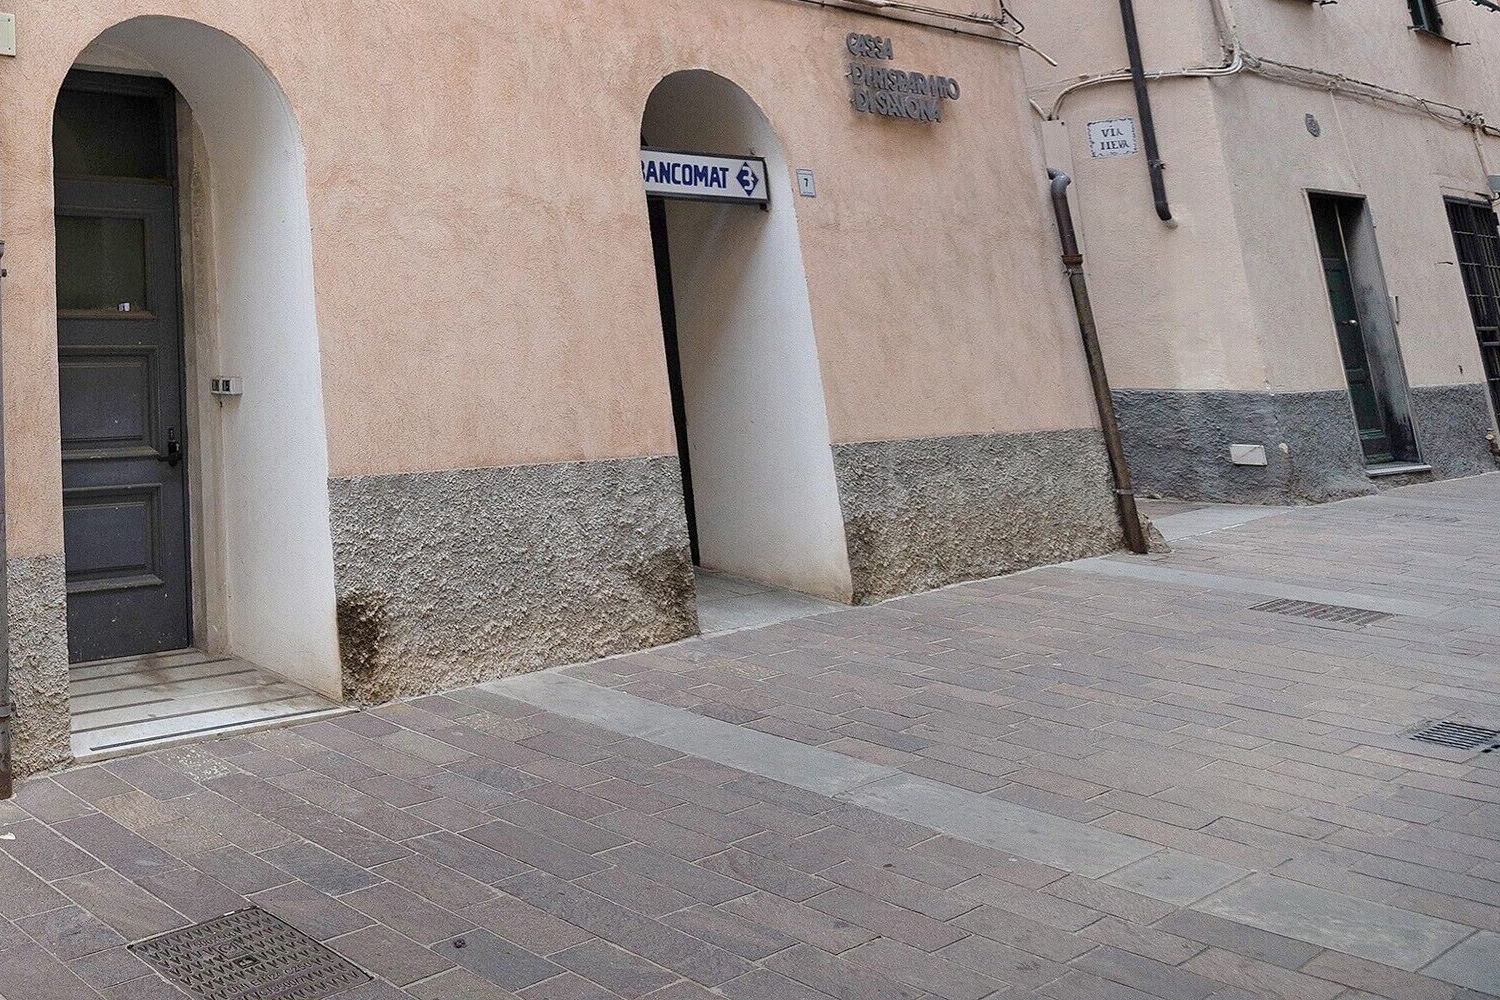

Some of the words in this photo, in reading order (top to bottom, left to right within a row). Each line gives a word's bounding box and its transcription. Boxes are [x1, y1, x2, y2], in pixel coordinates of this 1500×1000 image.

[846, 32, 893, 60] CASSA
[871, 66, 960, 100] RISPARMIO
[875, 90, 941, 123] SAVONA
[803, 178, 809, 187] 7
